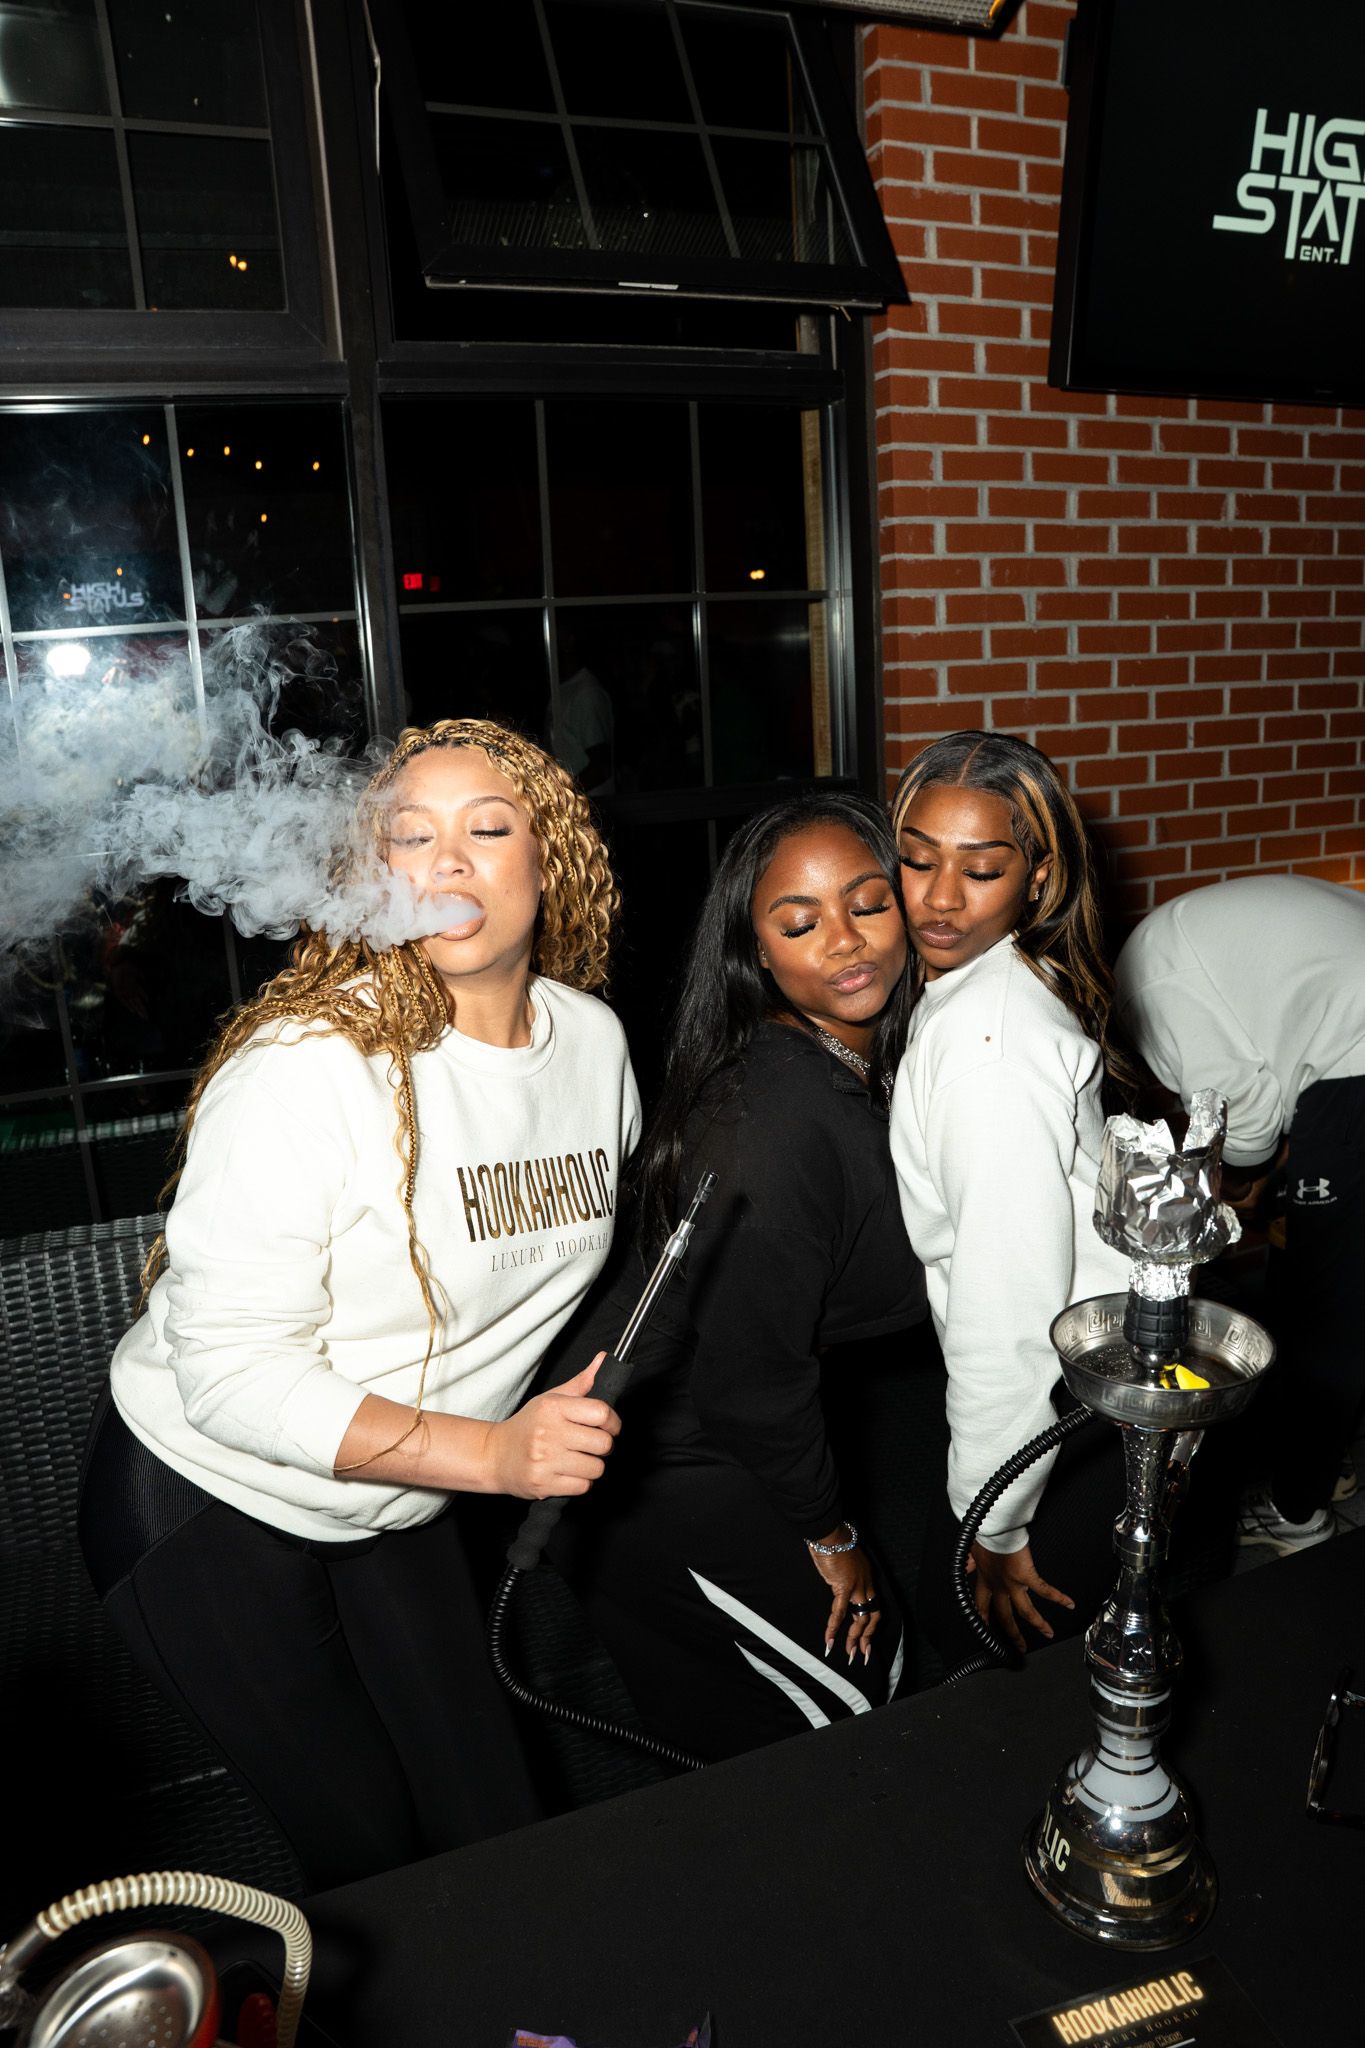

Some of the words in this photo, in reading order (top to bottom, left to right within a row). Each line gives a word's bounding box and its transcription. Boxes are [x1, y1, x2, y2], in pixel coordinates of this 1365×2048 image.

[1251, 108, 1365, 183] HIG
[1300, 245, 1339, 264] ENT.
[64, 588, 145, 613] STATUS
[71, 581, 121, 599] HIGH
[456, 1148, 614, 1243] HOOKAHHOLIC
[492, 1245, 545, 1272] LUXURY
[555, 1232, 609, 1258] HOOKAH
[1052, 1971, 1203, 2045] HOOKAHHOLIC
